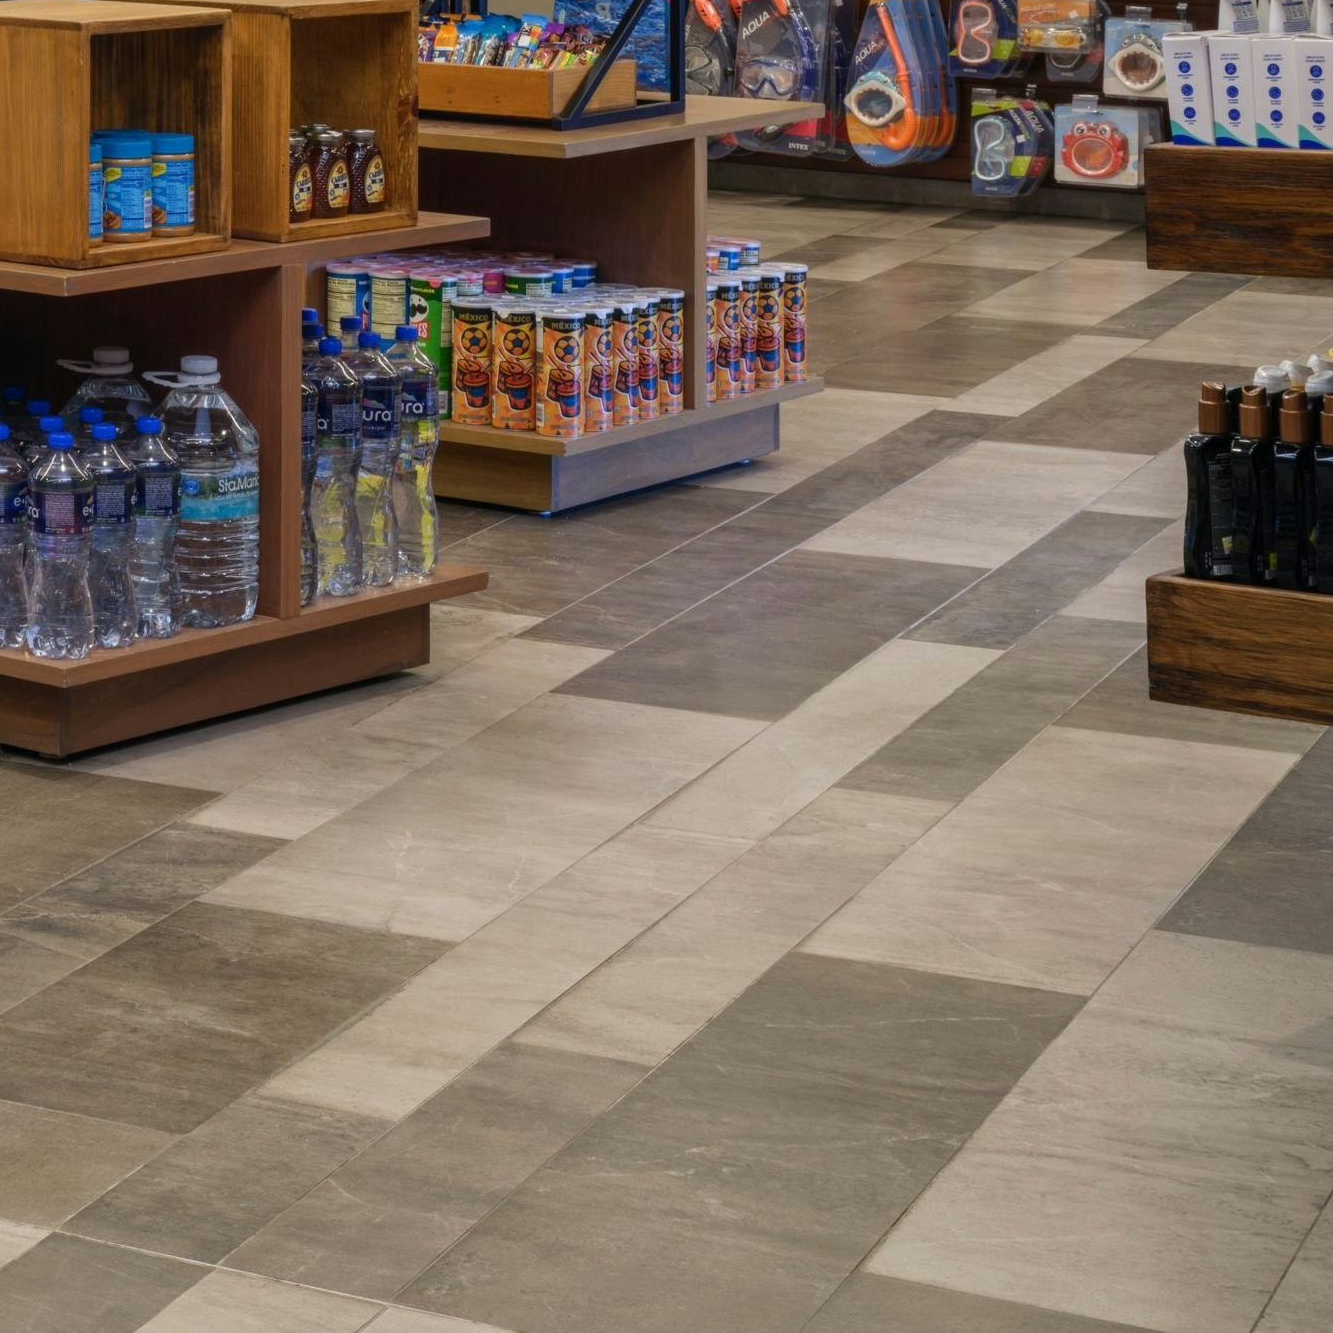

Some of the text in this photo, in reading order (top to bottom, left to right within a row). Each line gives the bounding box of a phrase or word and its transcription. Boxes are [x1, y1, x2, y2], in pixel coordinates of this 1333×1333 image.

[742, 11, 770, 39] AQUA
[855, 41, 878, 65] AQUA
[788, 142, 809, 151] INTEX
[552, 321, 581, 330] MÉXICO
